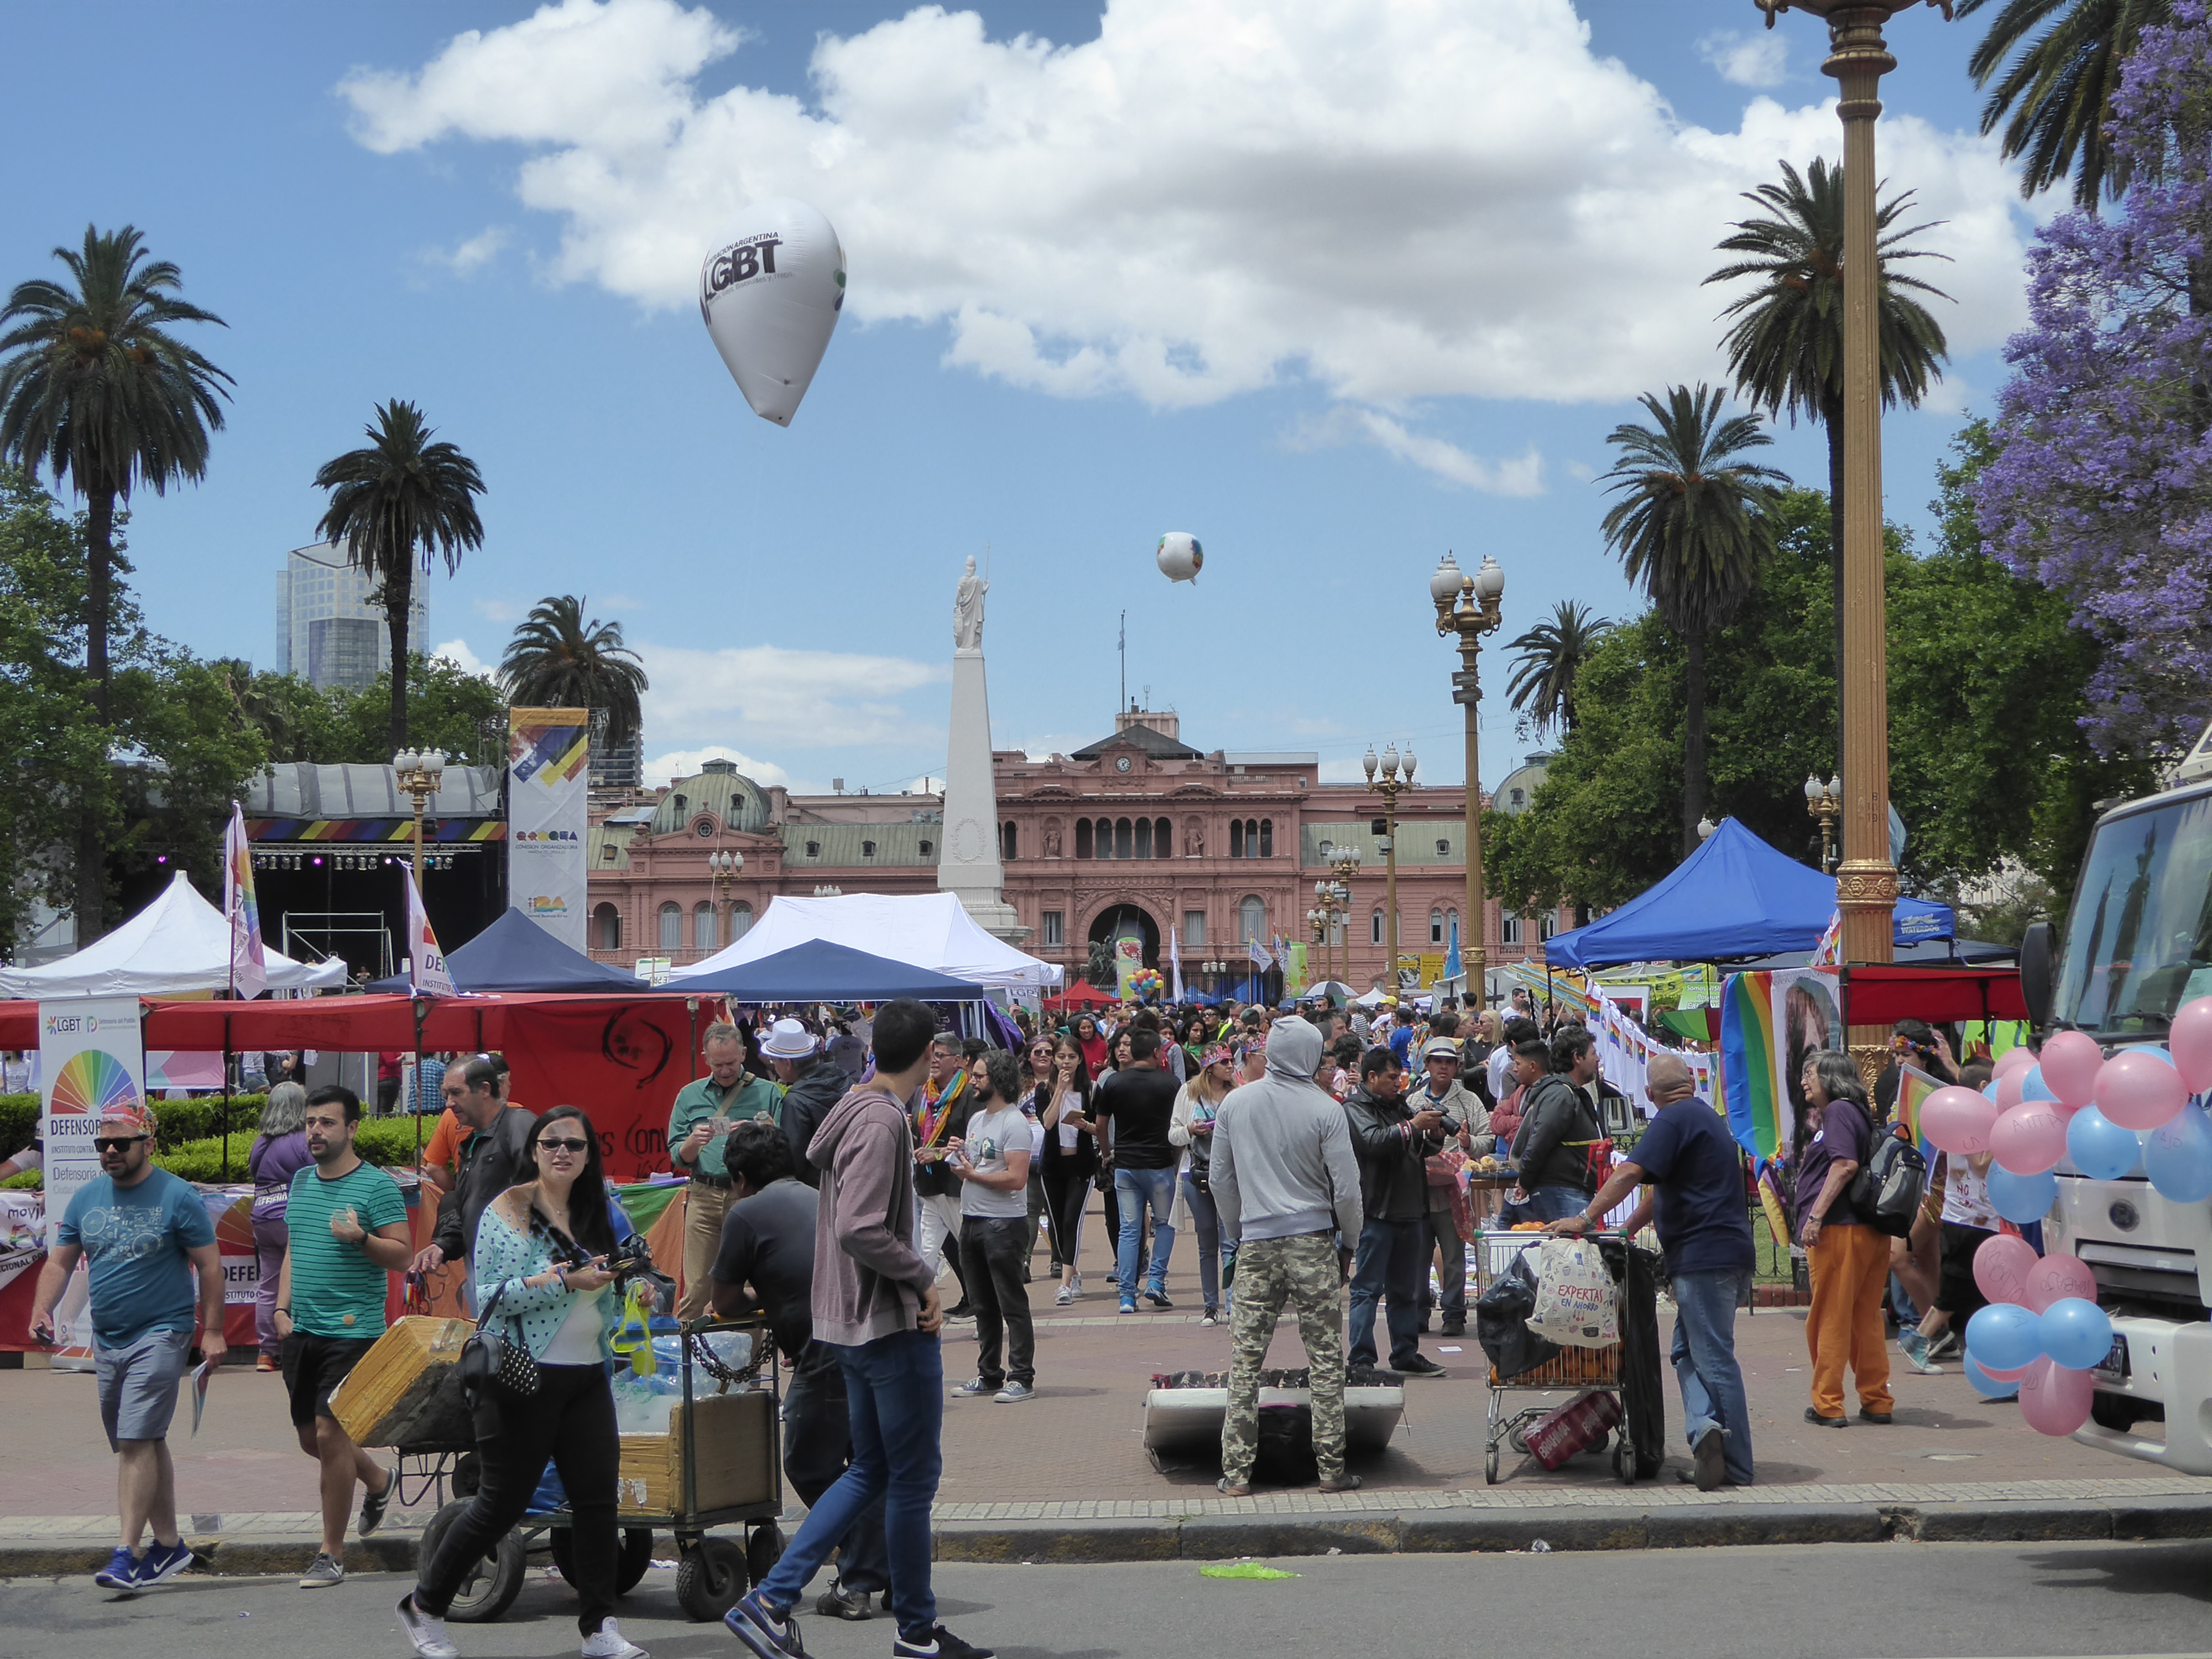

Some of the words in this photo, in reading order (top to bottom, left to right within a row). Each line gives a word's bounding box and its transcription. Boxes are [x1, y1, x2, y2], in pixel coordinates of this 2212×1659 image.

[734, 232, 779, 249] ARGENTINA
[704, 238, 783, 303] LGBT
[422, 979, 451, 992] INSTITUTO
[57, 1018, 81, 1032] LGBT
[76, 1145, 94, 1154] CONTRA
[53, 1167, 97, 1181] Defensoría
[0, 1259, 30, 1272] CIONAL
[1558, 1285, 1603, 1303] EXPERTAS
[1561, 1298, 1571, 1307] EN
[1573, 1300, 1599, 1311] AHORRO
[1538, 1421, 1571, 1460] BRAHMA
